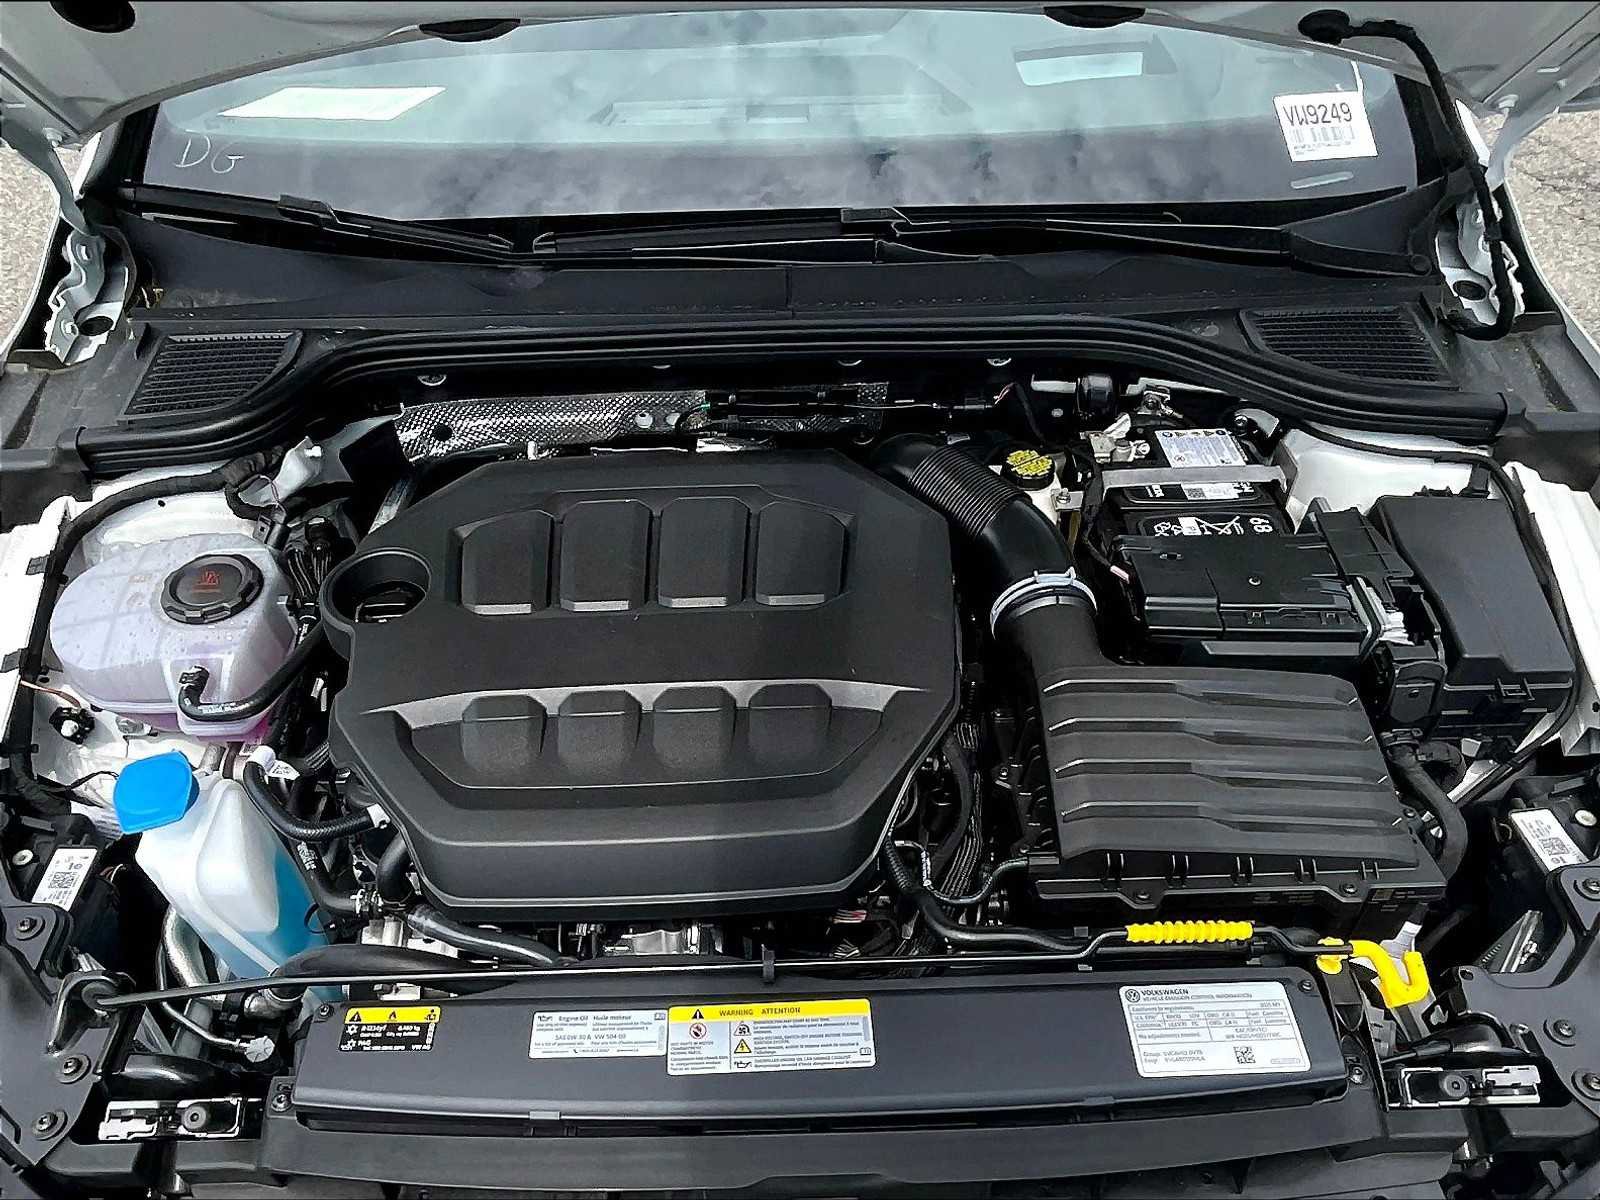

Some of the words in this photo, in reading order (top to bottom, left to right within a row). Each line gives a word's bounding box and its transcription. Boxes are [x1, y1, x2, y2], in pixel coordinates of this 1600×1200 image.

[1283, 102, 1352, 126] VW9249
[173, 136, 245, 174] DG
[1140, 988, 1190, 997] VOLKSWAGEN
[719, 1008, 754, 1017] WARNING
[761, 1006, 801, 1015] ATTENTION
